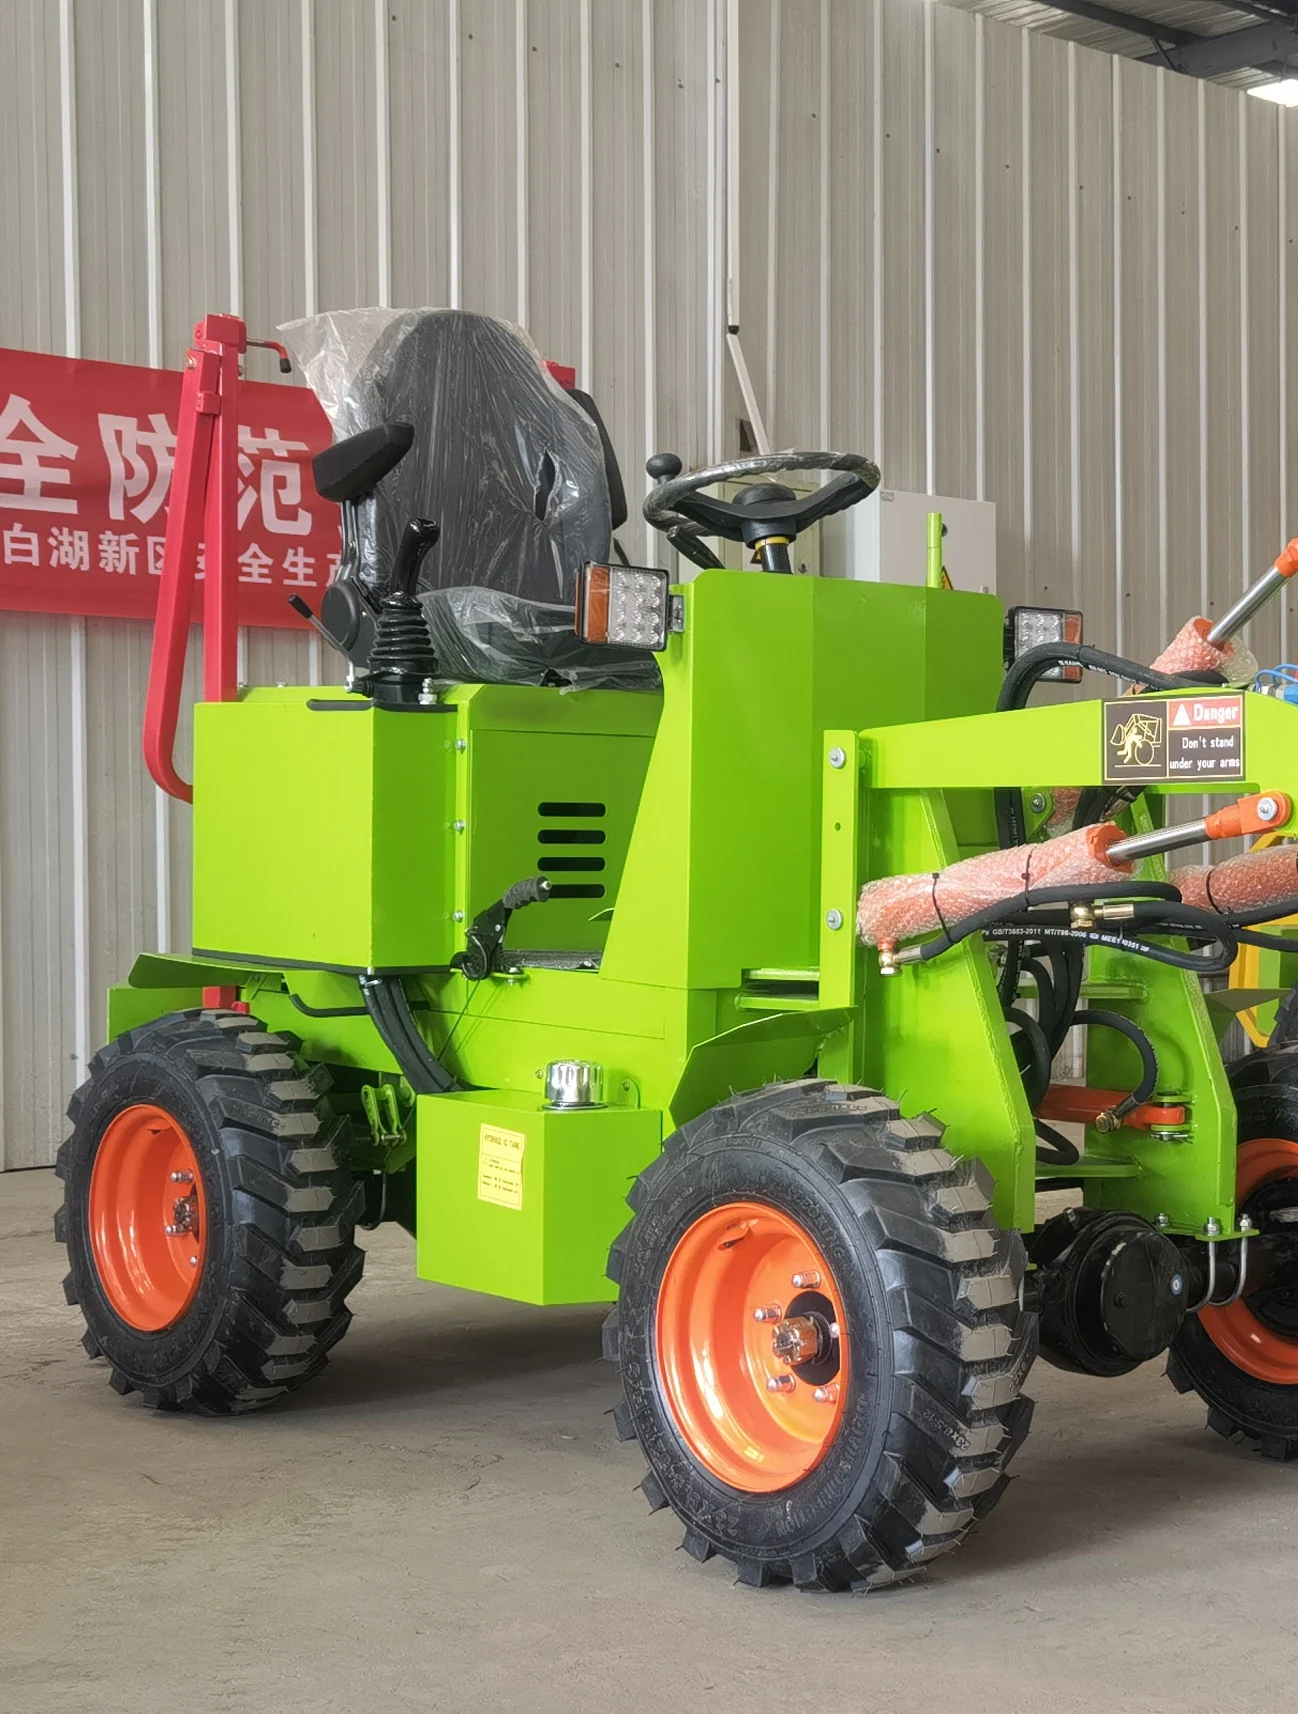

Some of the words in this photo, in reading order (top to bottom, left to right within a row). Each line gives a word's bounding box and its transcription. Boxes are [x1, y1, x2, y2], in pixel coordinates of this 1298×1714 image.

[1193, 703, 1238, 724] Danger
[1182, 736, 1207, 749] Don't
[1210, 735, 1234, 748] stand
[1169, 757, 1193, 770] under
[1197, 759, 1216, 772] your
[1219, 758, 1240, 769] arms
